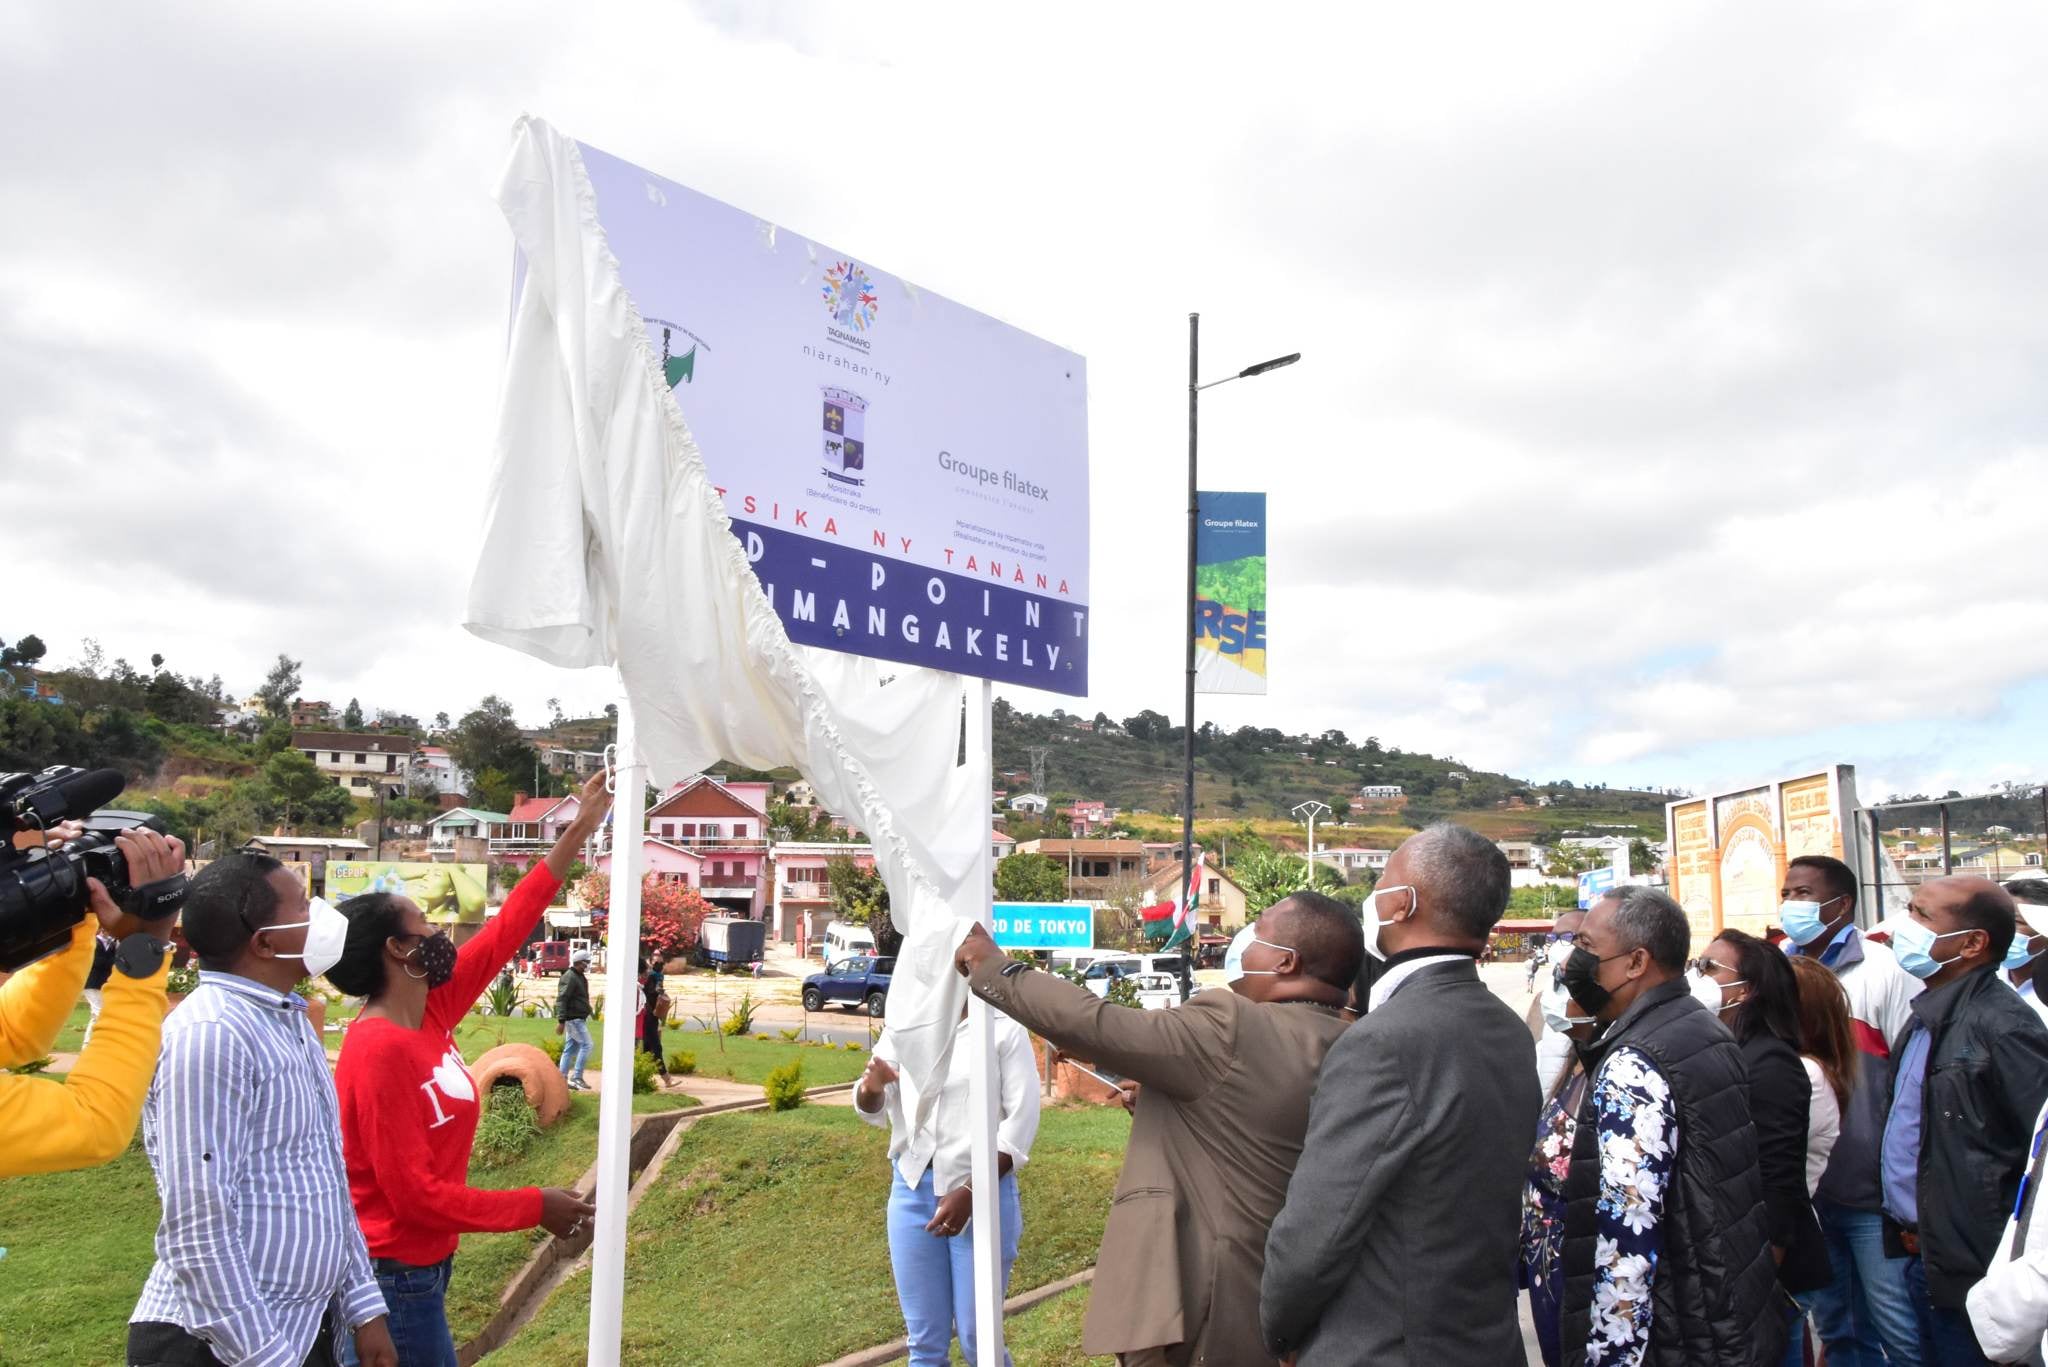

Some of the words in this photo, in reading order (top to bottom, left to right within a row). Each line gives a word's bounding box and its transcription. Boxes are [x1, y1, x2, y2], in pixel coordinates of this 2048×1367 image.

[803, 345, 890, 386] niarahan'ny
[938, 451, 999, 486] Groupe
[1002, 470, 1048, 502] filatex
[1204, 519, 1233, 528] Groupe
[1235, 519, 1258, 528] filatex
[873, 530, 912, 553] NY
[944, 549, 1069, 594] TANÀNA
[1195, 600, 1266, 654] RSE
[157, 888, 184, 903] SONY
[1014, 919, 1032, 934] DE
[1039, 919, 1086, 934] TOKYO
